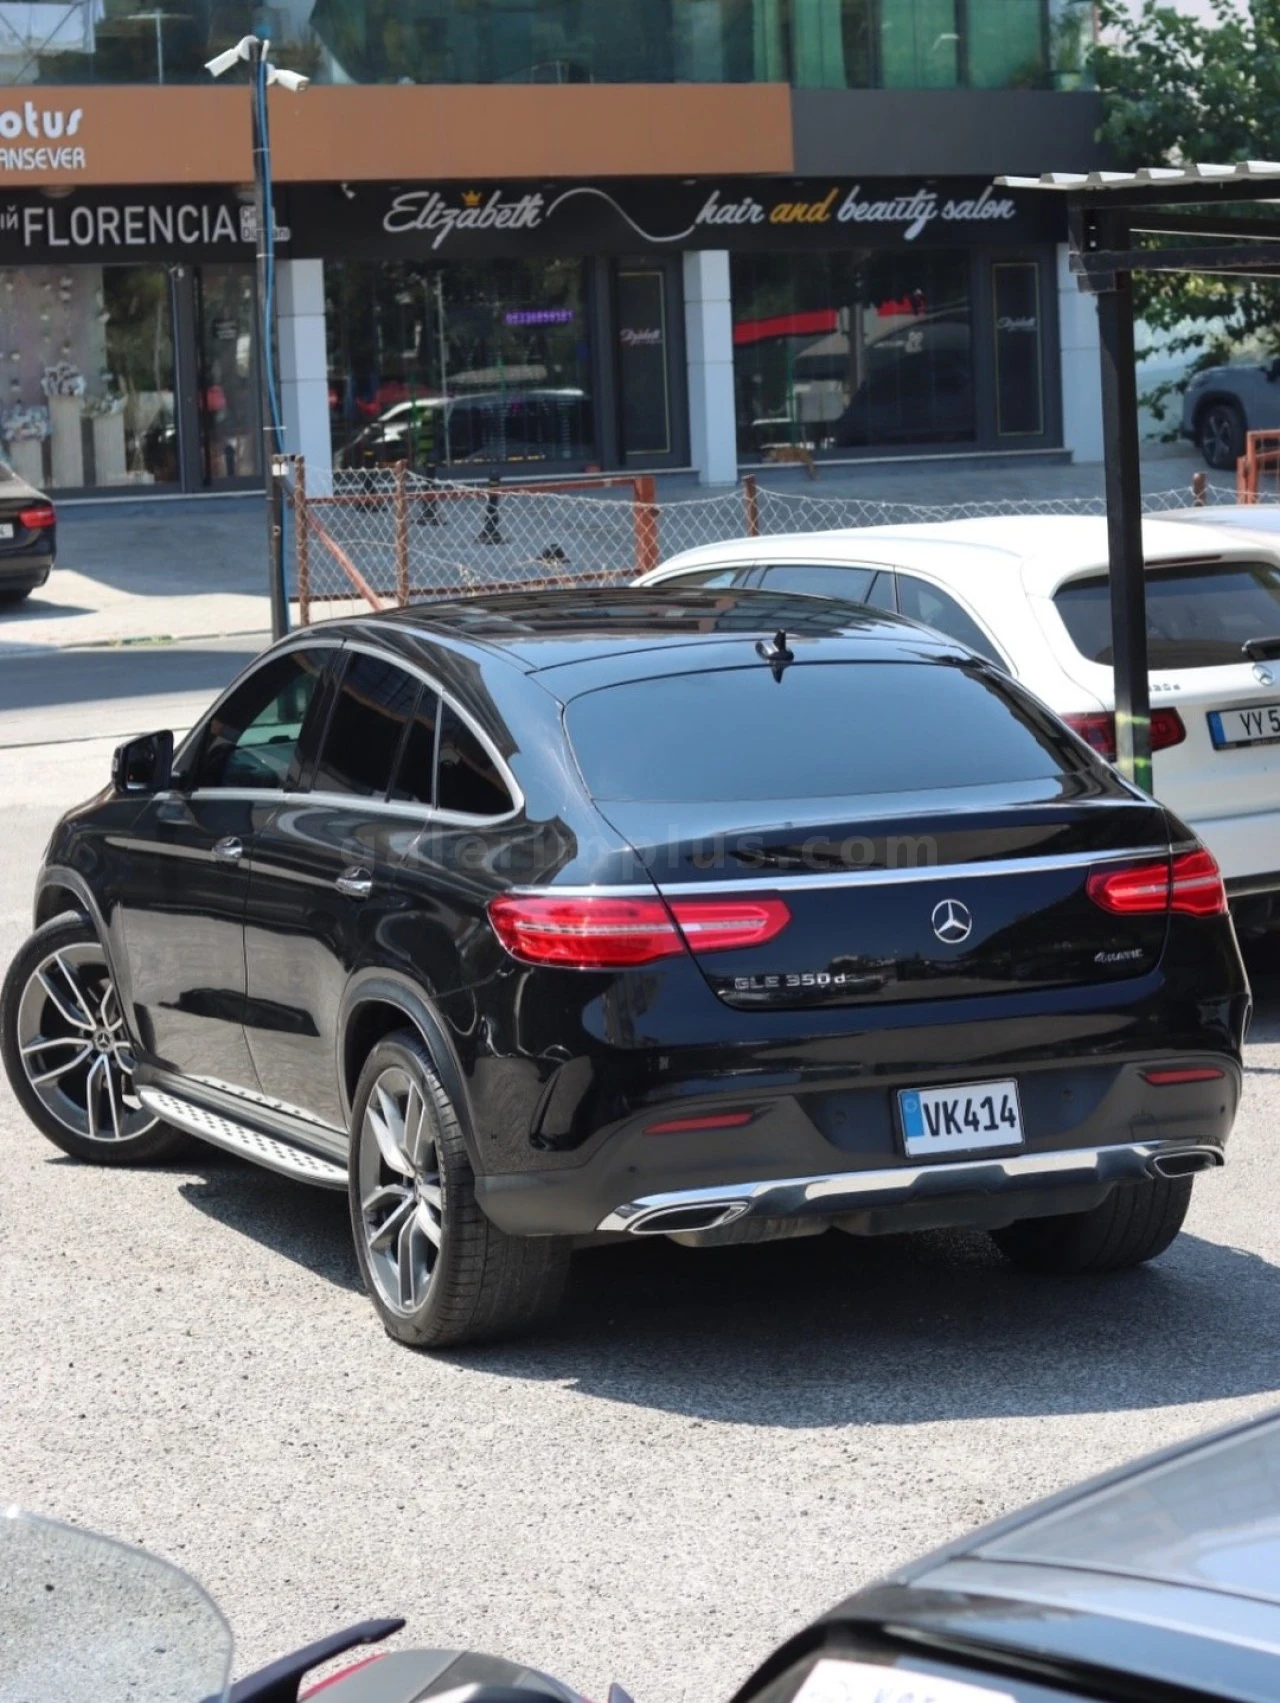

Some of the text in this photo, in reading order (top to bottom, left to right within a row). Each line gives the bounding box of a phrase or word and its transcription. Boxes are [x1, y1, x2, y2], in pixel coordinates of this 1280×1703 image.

[23, 204, 236, 246] FLORENCIA
[383, 190, 544, 250] Elizabeth
[695, 185, 1016, 240] hair and beauty salon
[1240, 711, 1262, 736] YY
[735, 976, 780, 990] GLE
[786, 972, 831, 988] 350
[923, 1094, 1017, 1136] VK414
